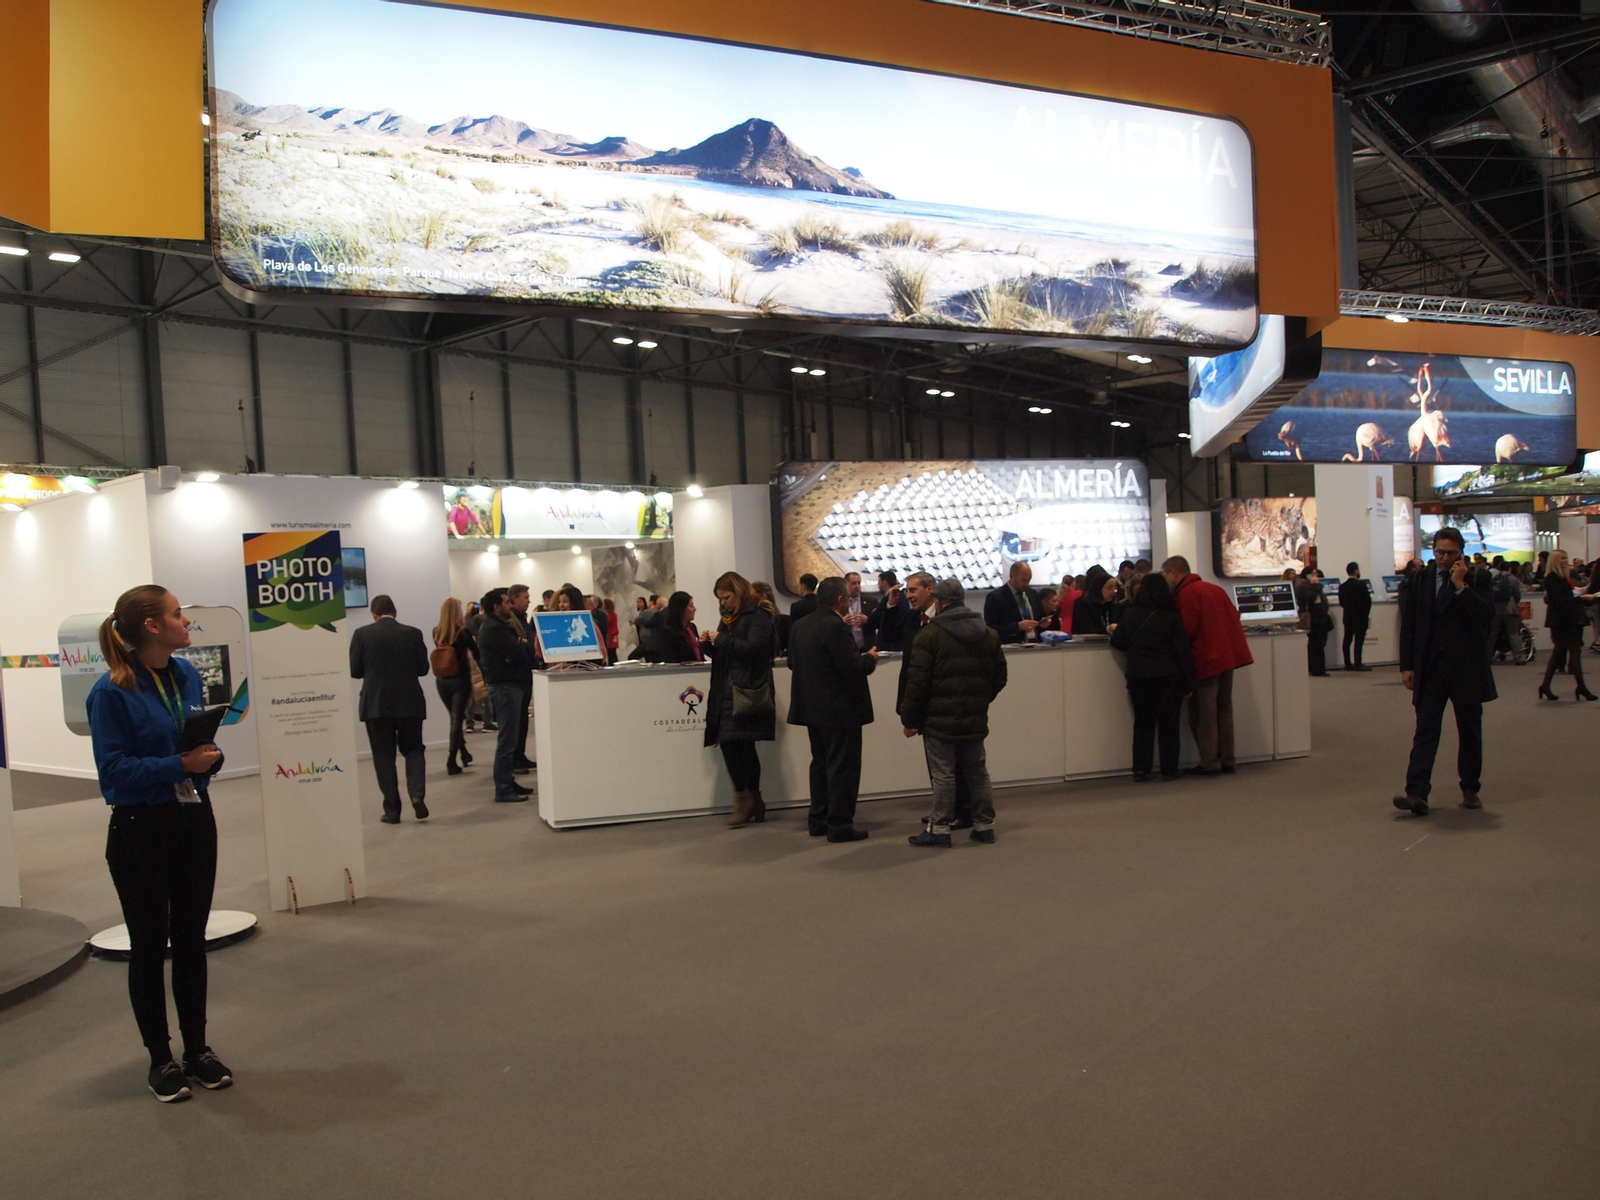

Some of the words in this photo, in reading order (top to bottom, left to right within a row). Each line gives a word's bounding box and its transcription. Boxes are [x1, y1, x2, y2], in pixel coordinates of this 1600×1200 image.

[1005, 105, 1238, 189] ALMERÍA
[263, 258, 295, 272] Playa
[297, 260, 313, 273] de
[314, 261, 336, 274] Los
[402, 265, 442, 280] Parque
[443, 268, 483, 280] Natural
[485, 270, 512, 283] Cabo
[1493, 366, 1572, 395] SEVILLA
[1014, 462, 1142, 498] ALMERÍA
[546, 503, 606, 521] Andalucía
[1491, 517, 1531, 530] HUELVA
[256, 557, 332, 579] PHOTO
[258, 581, 334, 605] BOOTH
[271, 693, 336, 705] #andaluciaenfitur
[275, 758, 344, 779] Andalucía
